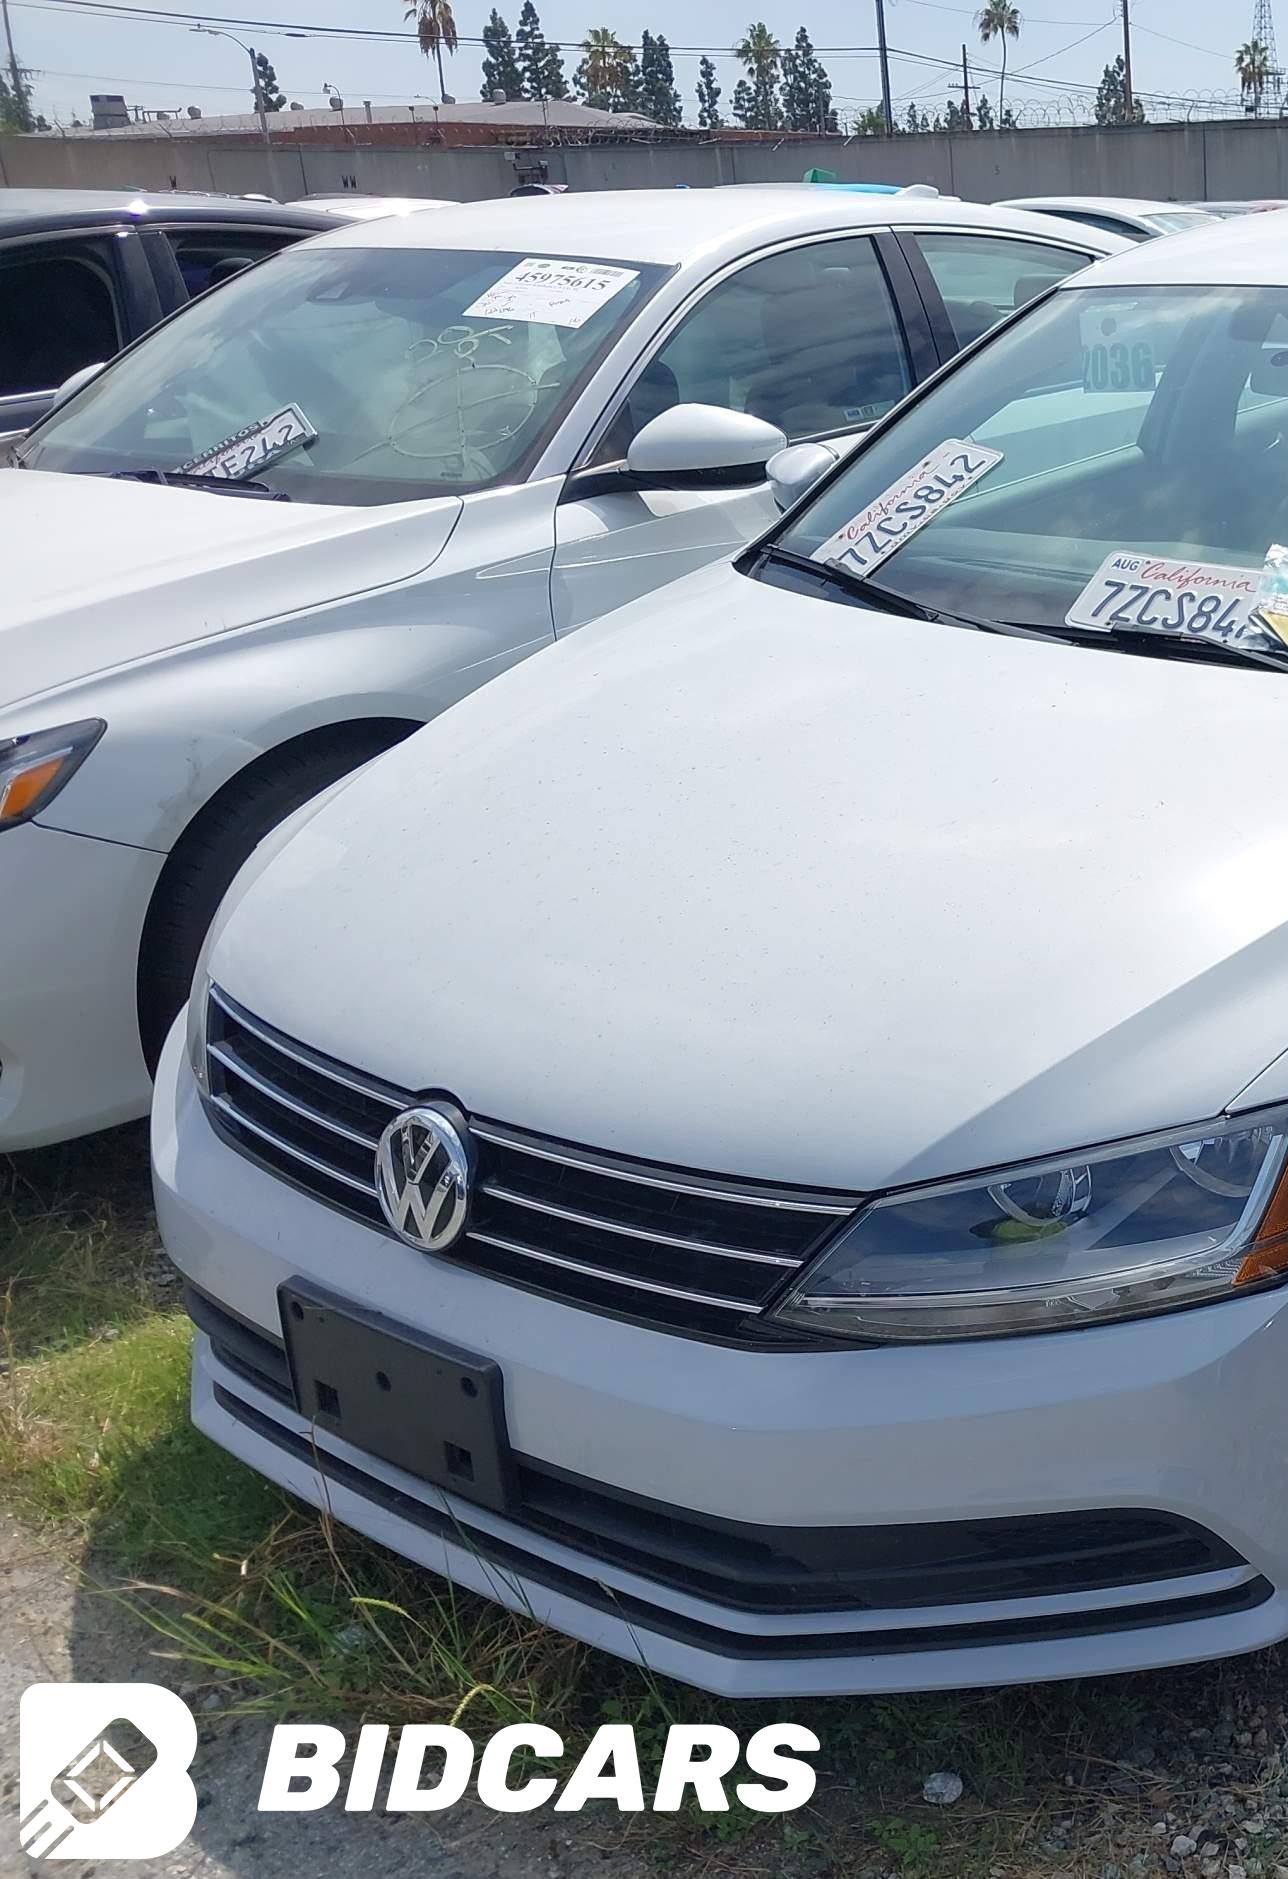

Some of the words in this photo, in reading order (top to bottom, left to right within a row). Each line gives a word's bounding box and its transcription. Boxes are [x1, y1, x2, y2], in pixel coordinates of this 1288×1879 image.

[514, 270, 611, 291] 45975615
[837, 454, 986, 566] 7ZCS842
[846, 463, 940, 541] California
[1111, 557, 1141, 573] AUG
[1140, 560, 1257, 594] California
